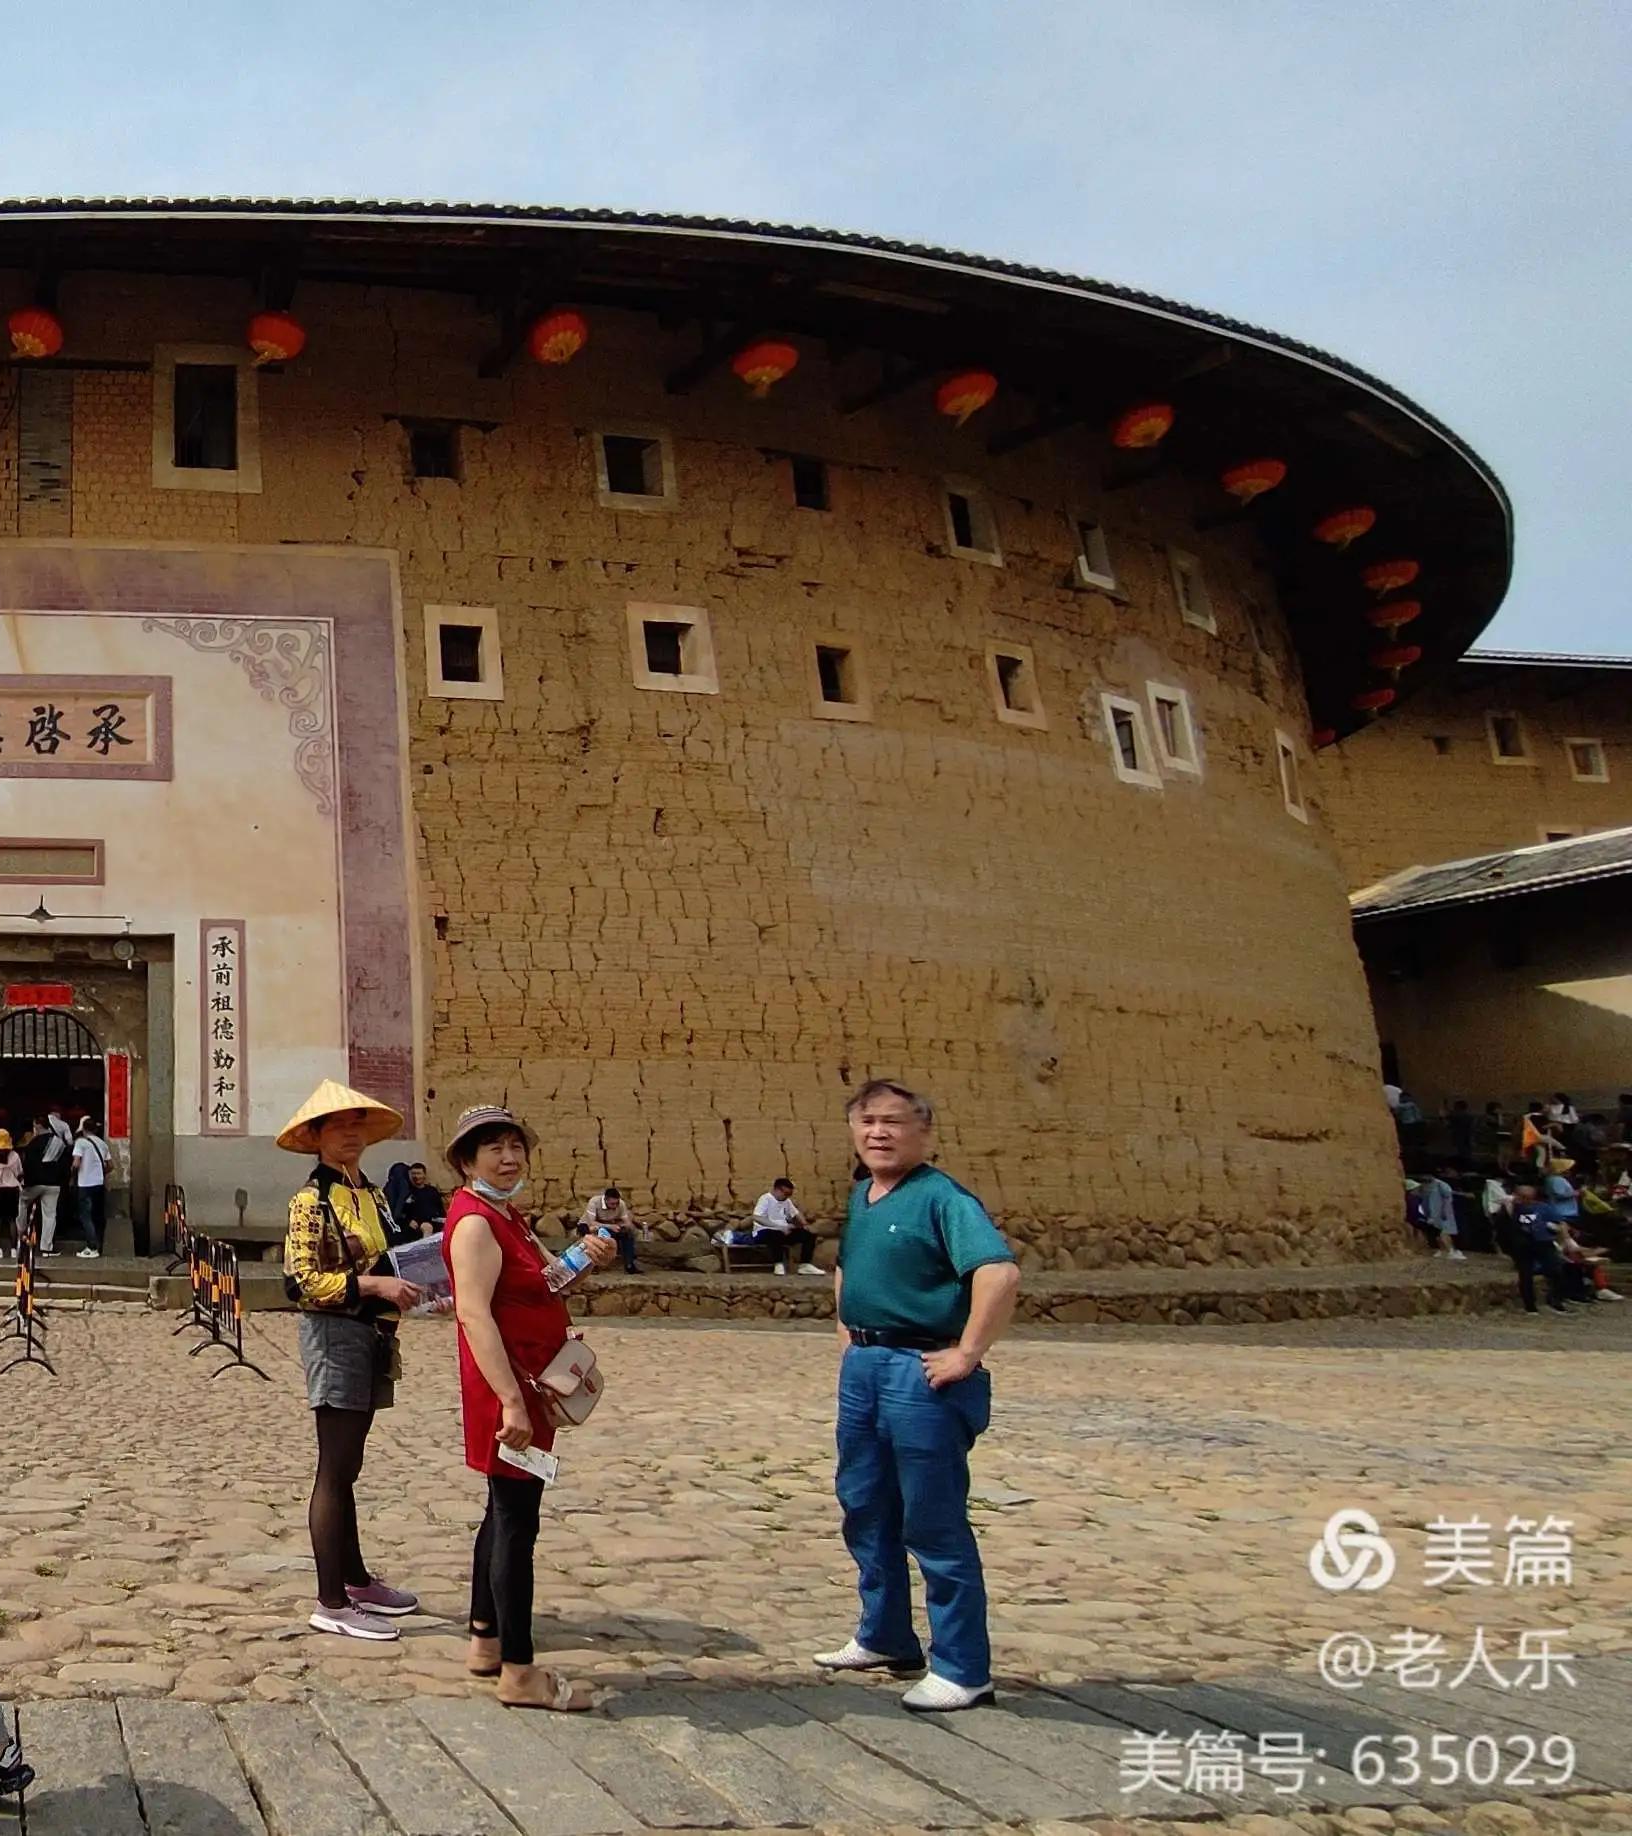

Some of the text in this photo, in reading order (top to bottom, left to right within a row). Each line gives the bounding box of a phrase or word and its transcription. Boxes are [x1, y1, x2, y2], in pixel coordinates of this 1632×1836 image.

[210, 936, 236, 1124] 承前祖德勤和儉
